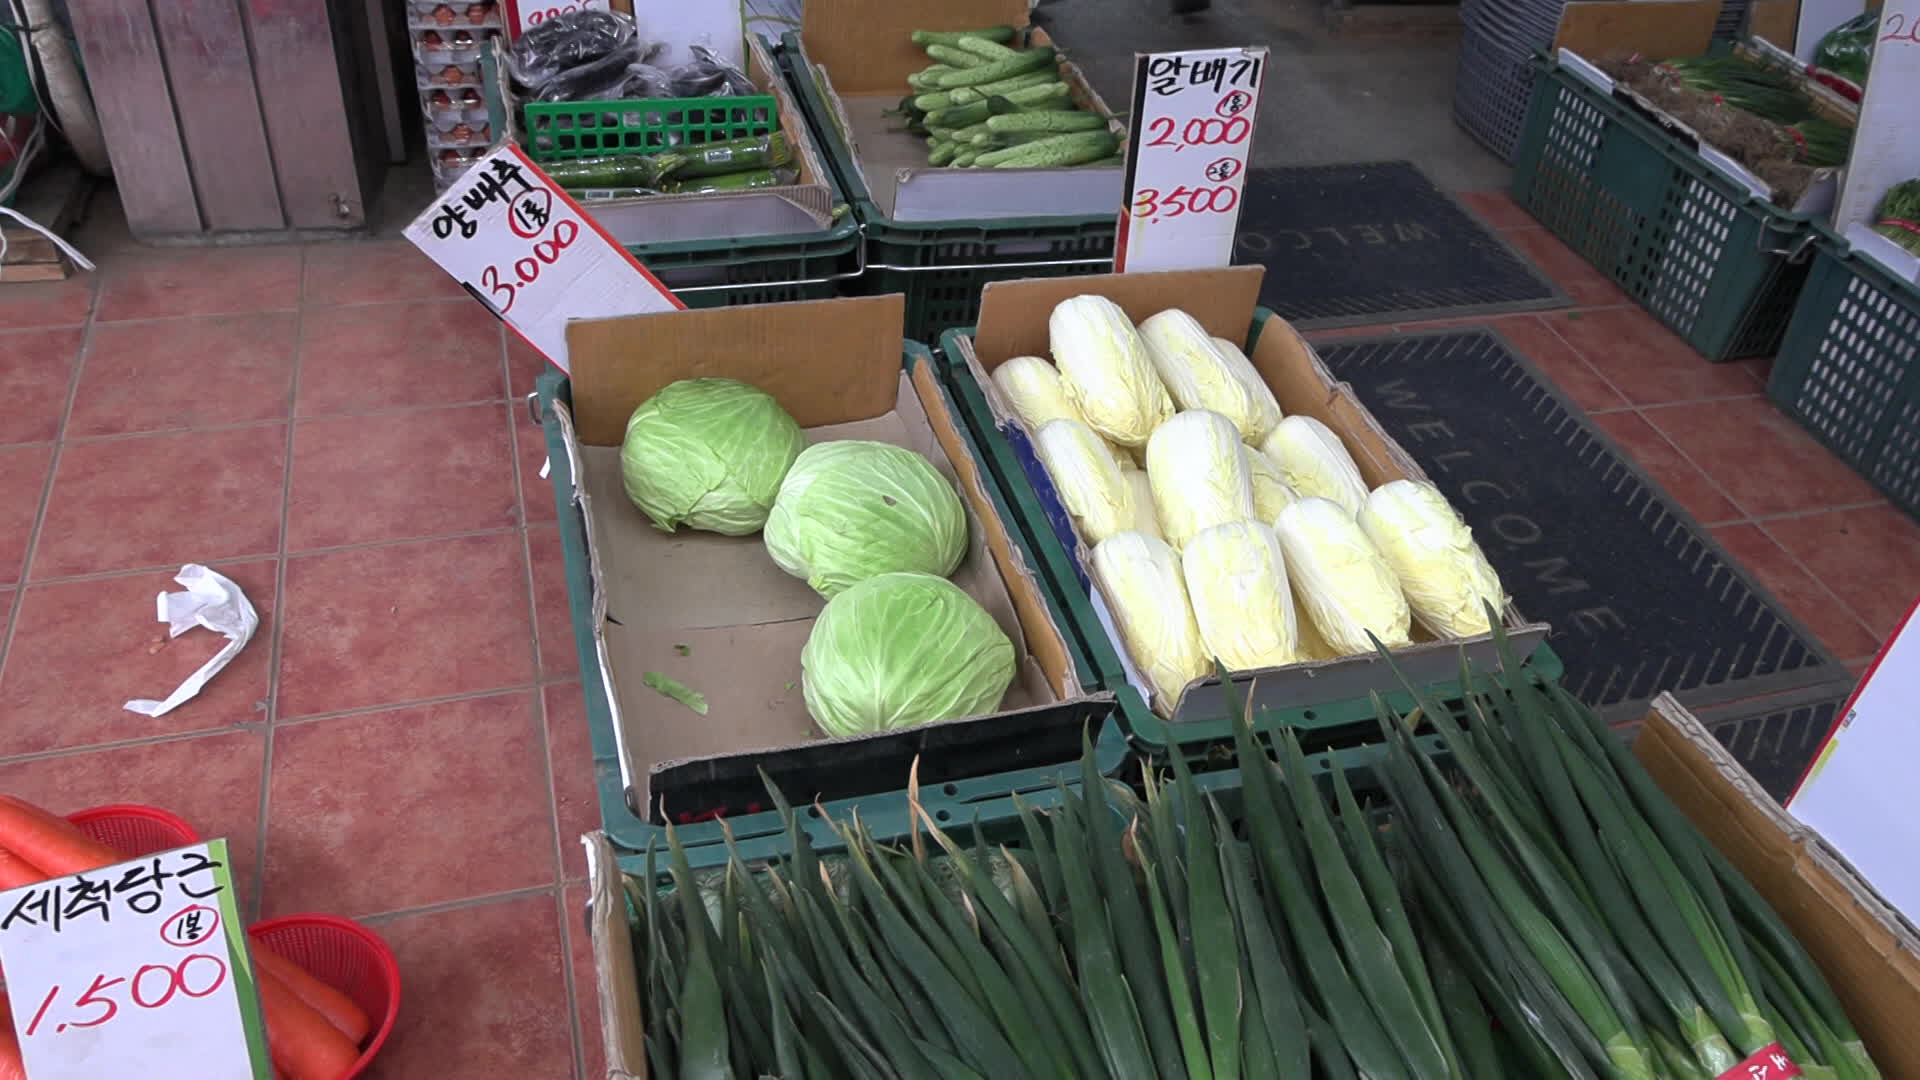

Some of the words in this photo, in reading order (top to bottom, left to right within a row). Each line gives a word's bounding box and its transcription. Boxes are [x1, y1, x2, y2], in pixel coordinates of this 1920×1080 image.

[1149, 56, 1261, 96] 알배기
[1145, 116, 1250, 152] 2,000
[432, 158, 535, 240] 양배추
[1374, 380, 1625, 634] WELCOME
[0, 853, 225, 932] 세척당근
[26, 953, 227, 1036] 1.500
